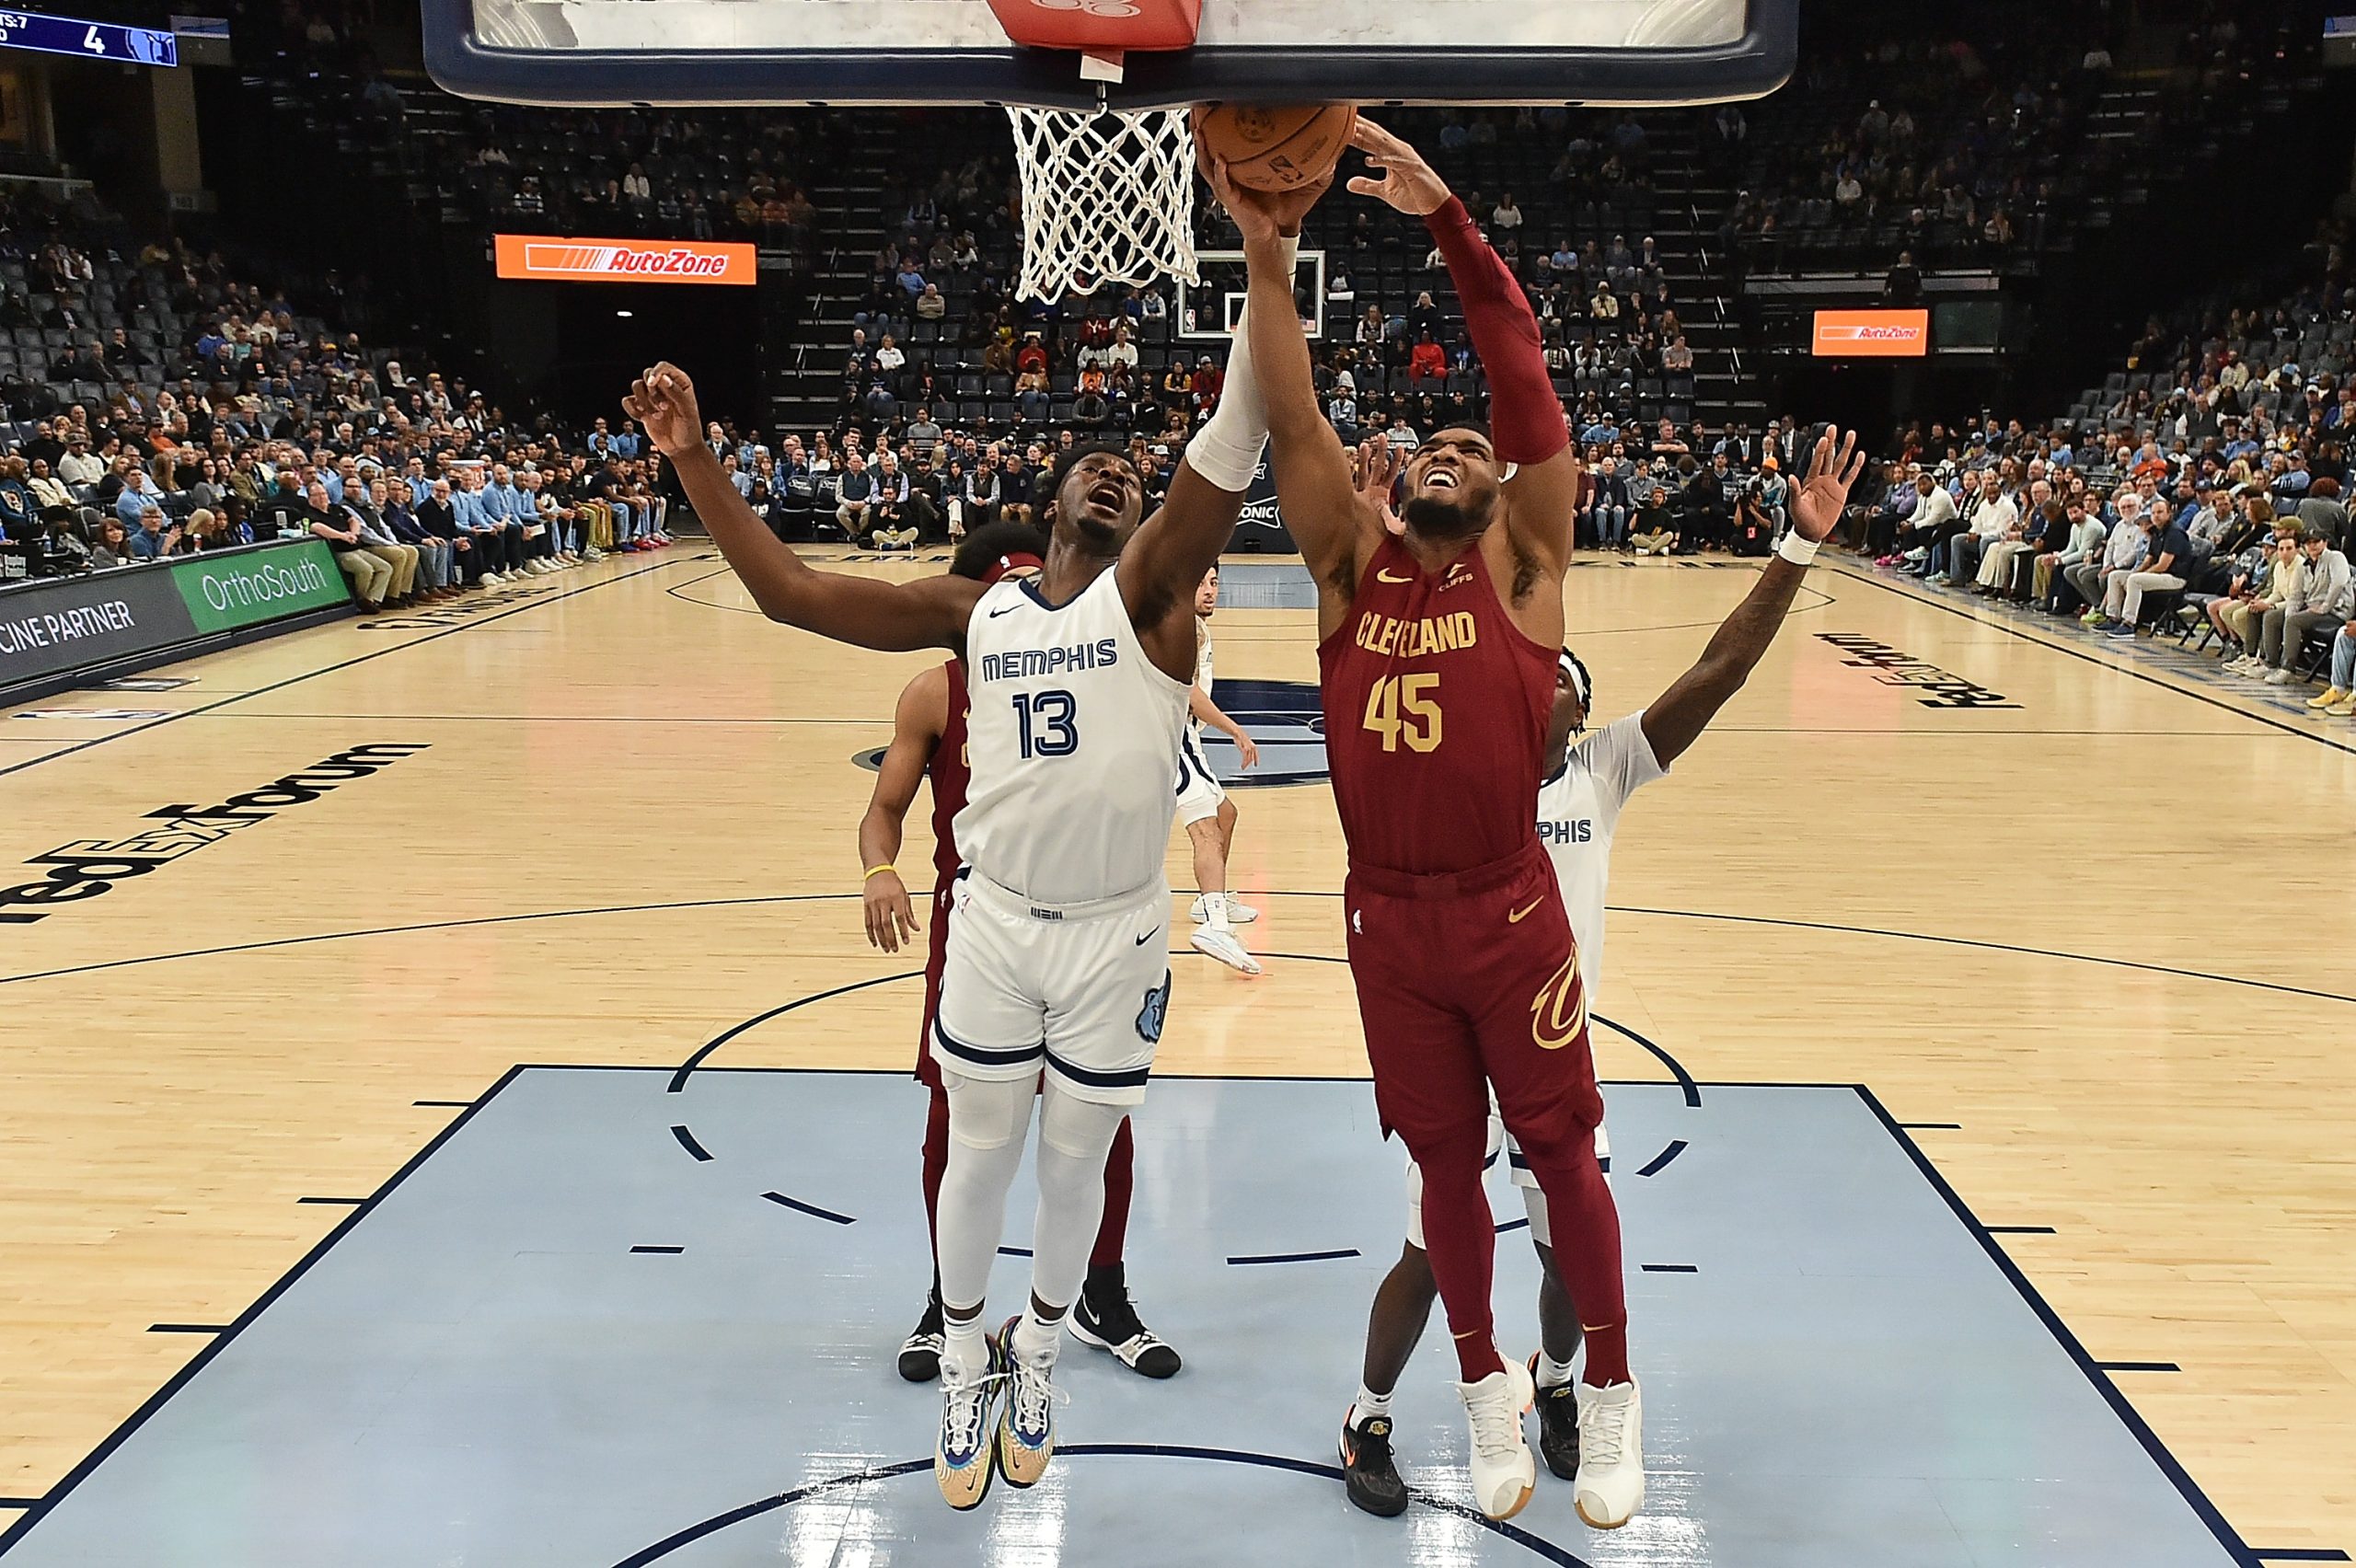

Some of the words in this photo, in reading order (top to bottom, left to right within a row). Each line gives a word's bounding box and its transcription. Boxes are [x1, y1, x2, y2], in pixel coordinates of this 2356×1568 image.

[84, 25, 106, 53] 4
[607, 248, 726, 274] AutoZone
[1858, 327, 1917, 340] AutoZone
[1238, 506, 1276, 519] ONIC
[202, 558, 328, 610] OrthoSouth
[1438, 572, 1474, 593] CLIFFS
[43, 601, 136, 643] PARTNER
[982, 638, 1118, 682] MEMPHIS
[1012, 689, 1080, 759] 13
[1362, 673, 1442, 753] 45
[1536, 819, 1591, 845] PHIS
